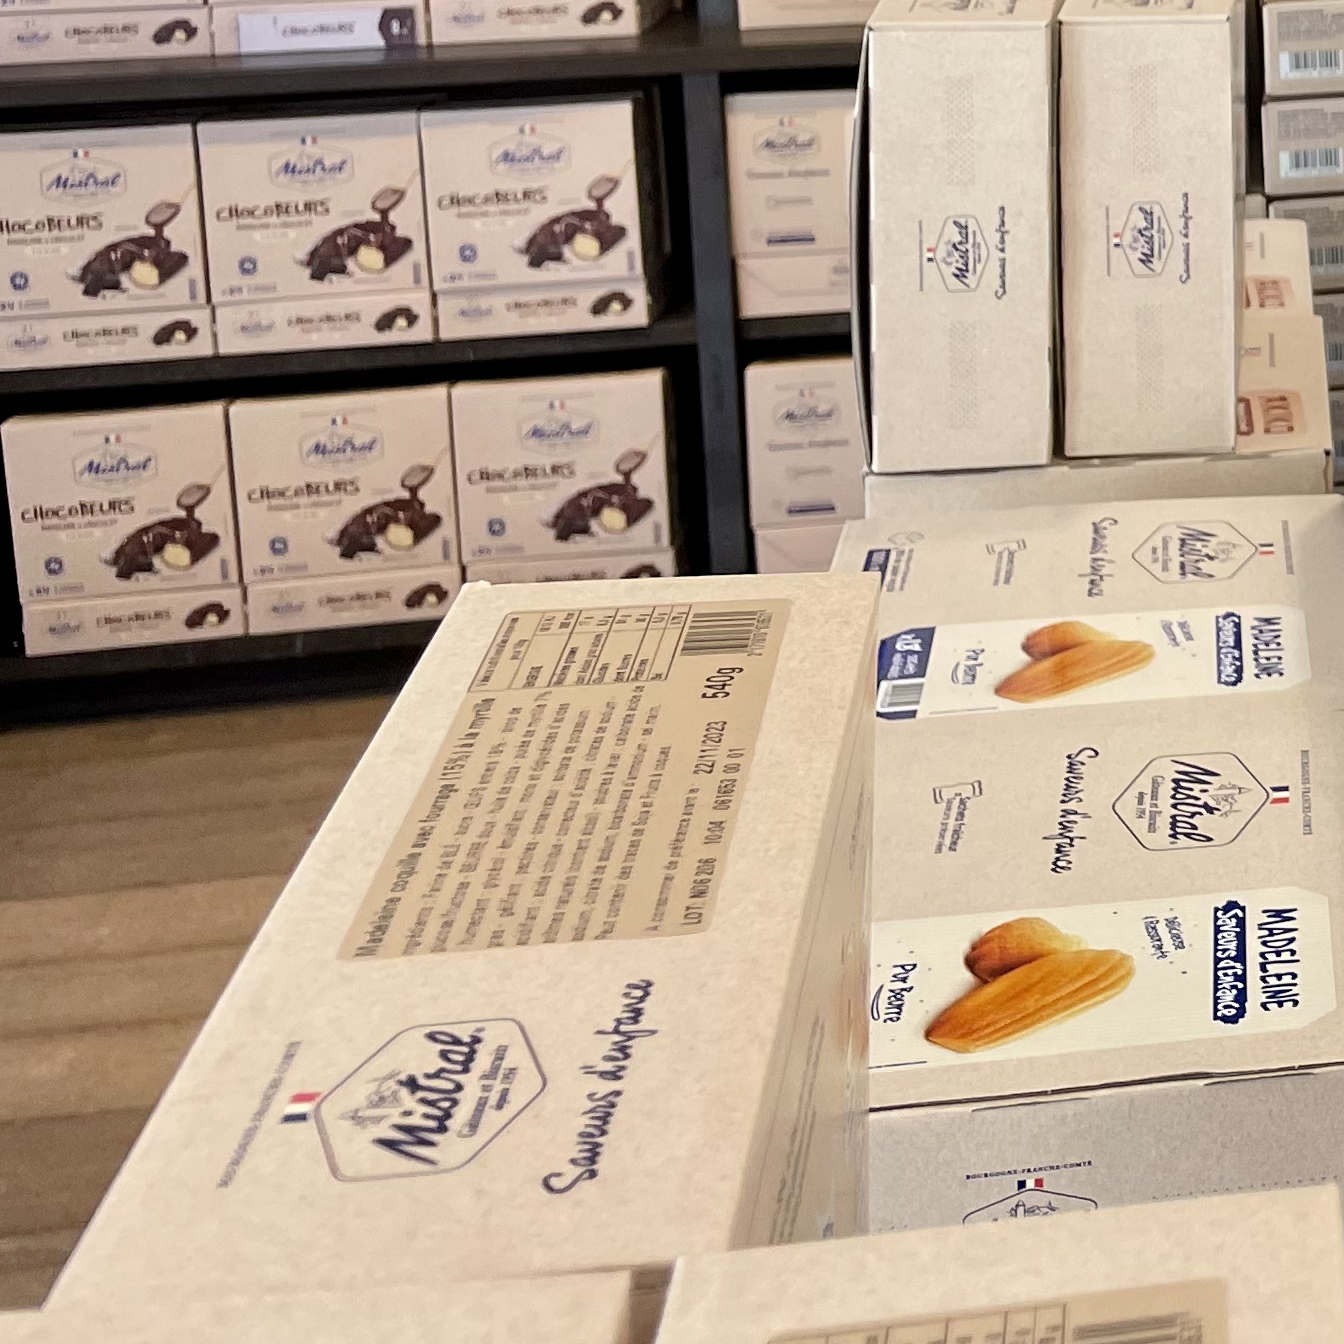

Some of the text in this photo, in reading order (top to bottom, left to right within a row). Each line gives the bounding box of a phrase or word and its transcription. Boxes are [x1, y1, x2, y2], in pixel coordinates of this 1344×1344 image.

[950, 219, 970, 289] Mistral
[1136, 205, 1155, 273] Mistral
[1176, 524, 1219, 580] Mistral
[1250, 616, 1285, 679] MADELEINE
[693, 666, 744, 775] 22/11/2023 540g
[1042, 747, 1100, 874] Saveurs d'enfance
[1167, 759, 1221, 843] Mistral
[882, 962, 918, 1024] Pur Beurre
[1216, 908, 1243, 1017] Saveurs d'Enfance
[1257, 908, 1300, 1011] MADELEINE
[372, 1029, 477, 1167] Mistral
[540, 978, 659, 1195] Saveurs d'enfance
